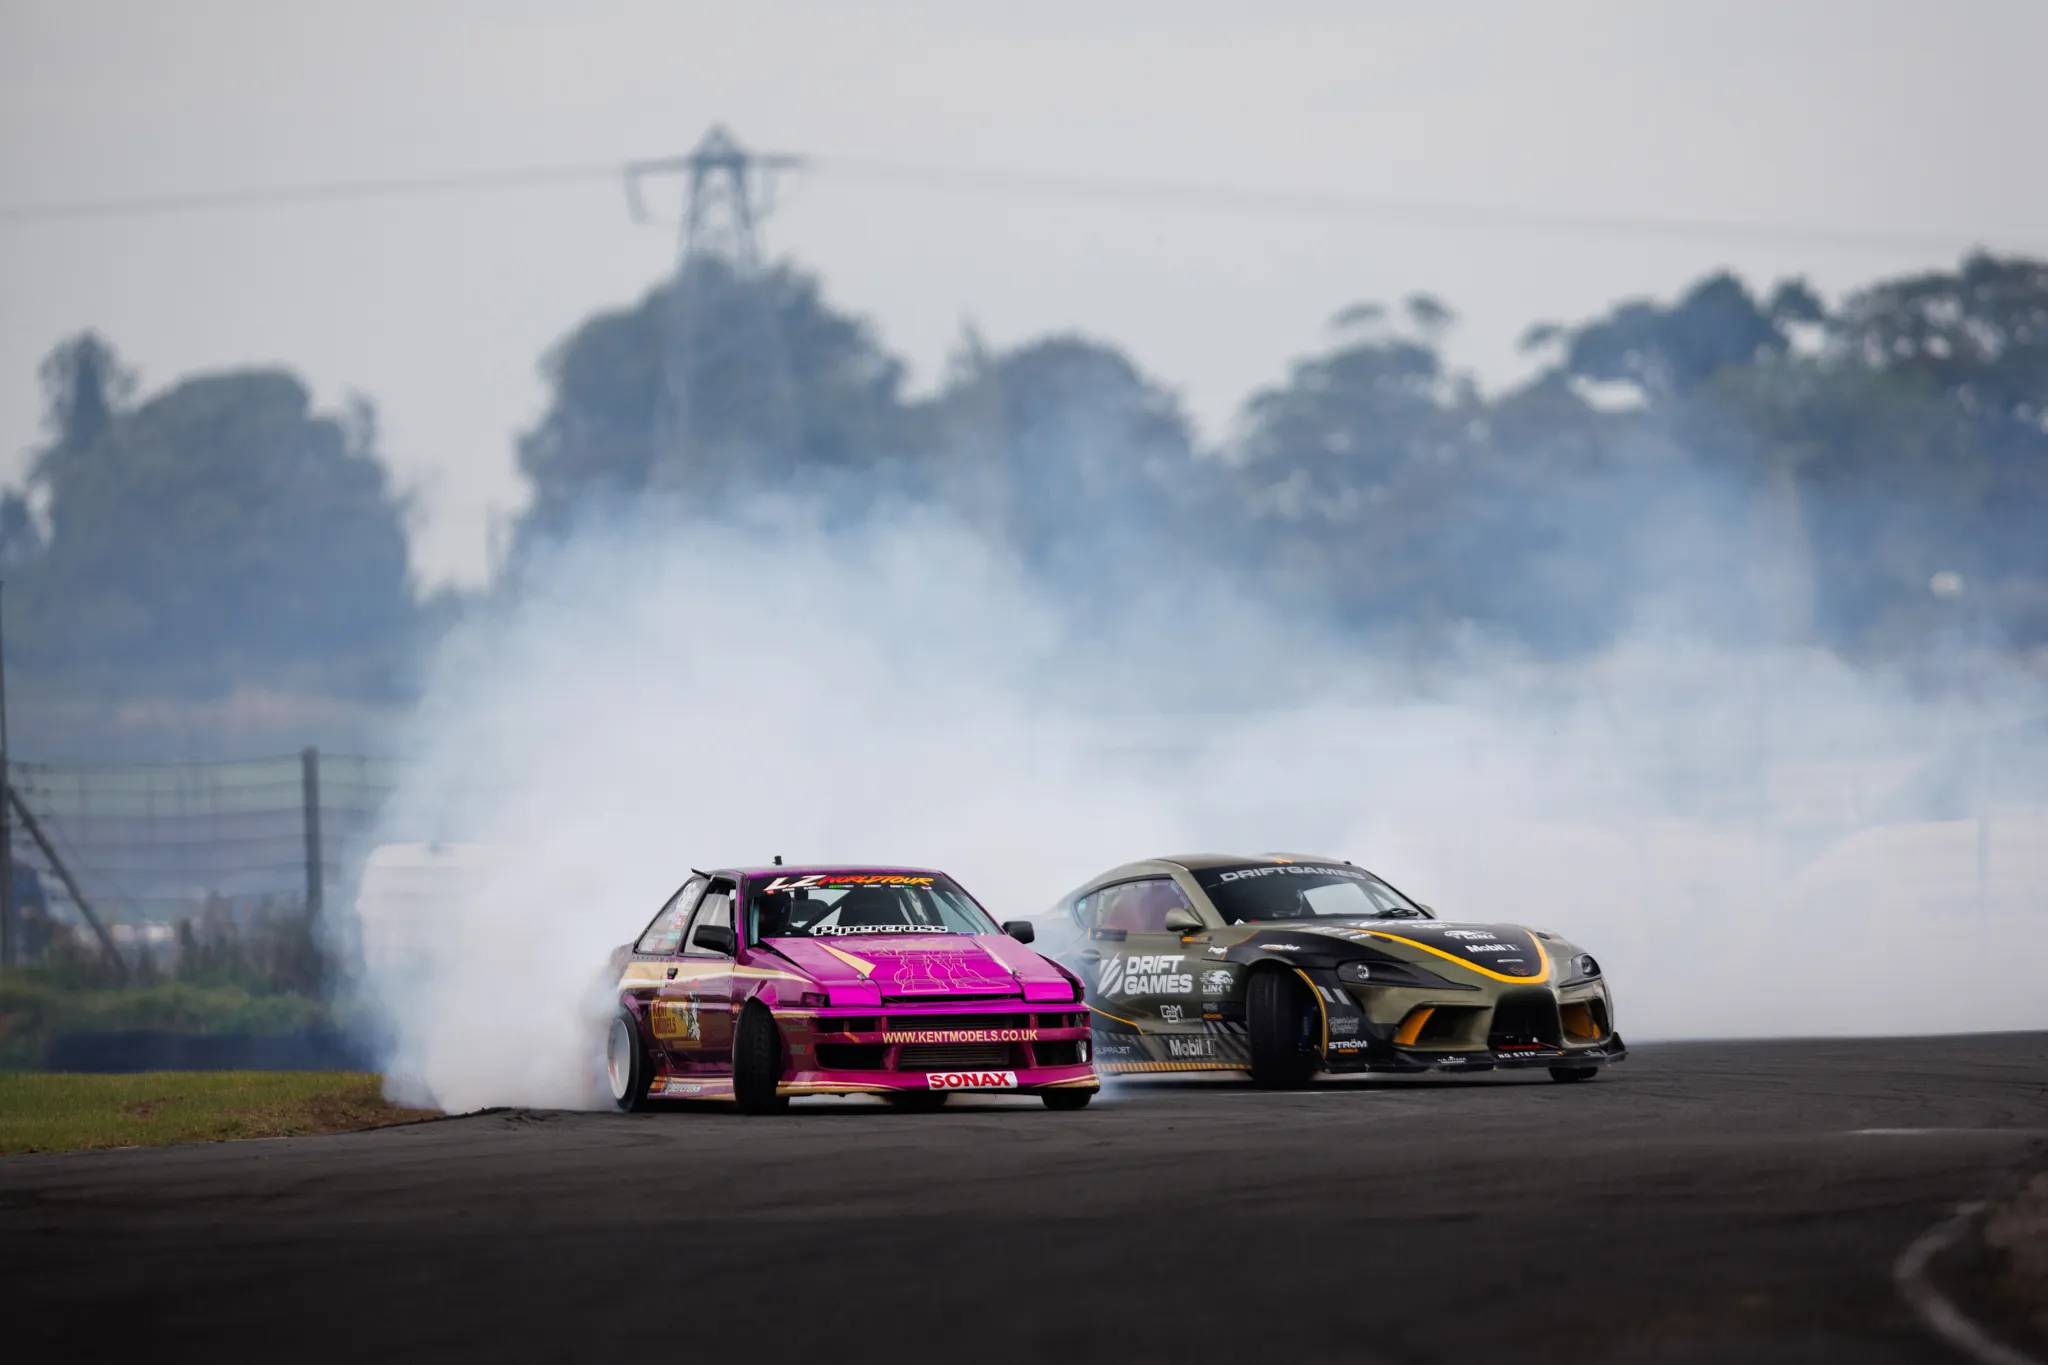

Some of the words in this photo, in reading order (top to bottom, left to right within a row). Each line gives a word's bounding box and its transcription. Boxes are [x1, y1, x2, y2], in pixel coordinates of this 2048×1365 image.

[1220, 866, 1365, 882] DRIFTGAMES
[813, 924, 949, 936] Pipercross
[1465, 944, 1506, 953] Mobil
[1125, 955, 1185, 974] DRIFT
[1124, 974, 1193, 995] GAMES
[882, 1029, 1038, 1044] WWW.KENTMODELS.CO.UK
[1328, 1038, 1368, 1049] STRÖM
[1169, 1039, 1203, 1056] Mobil
[929, 1072, 1011, 1089] SONAX
